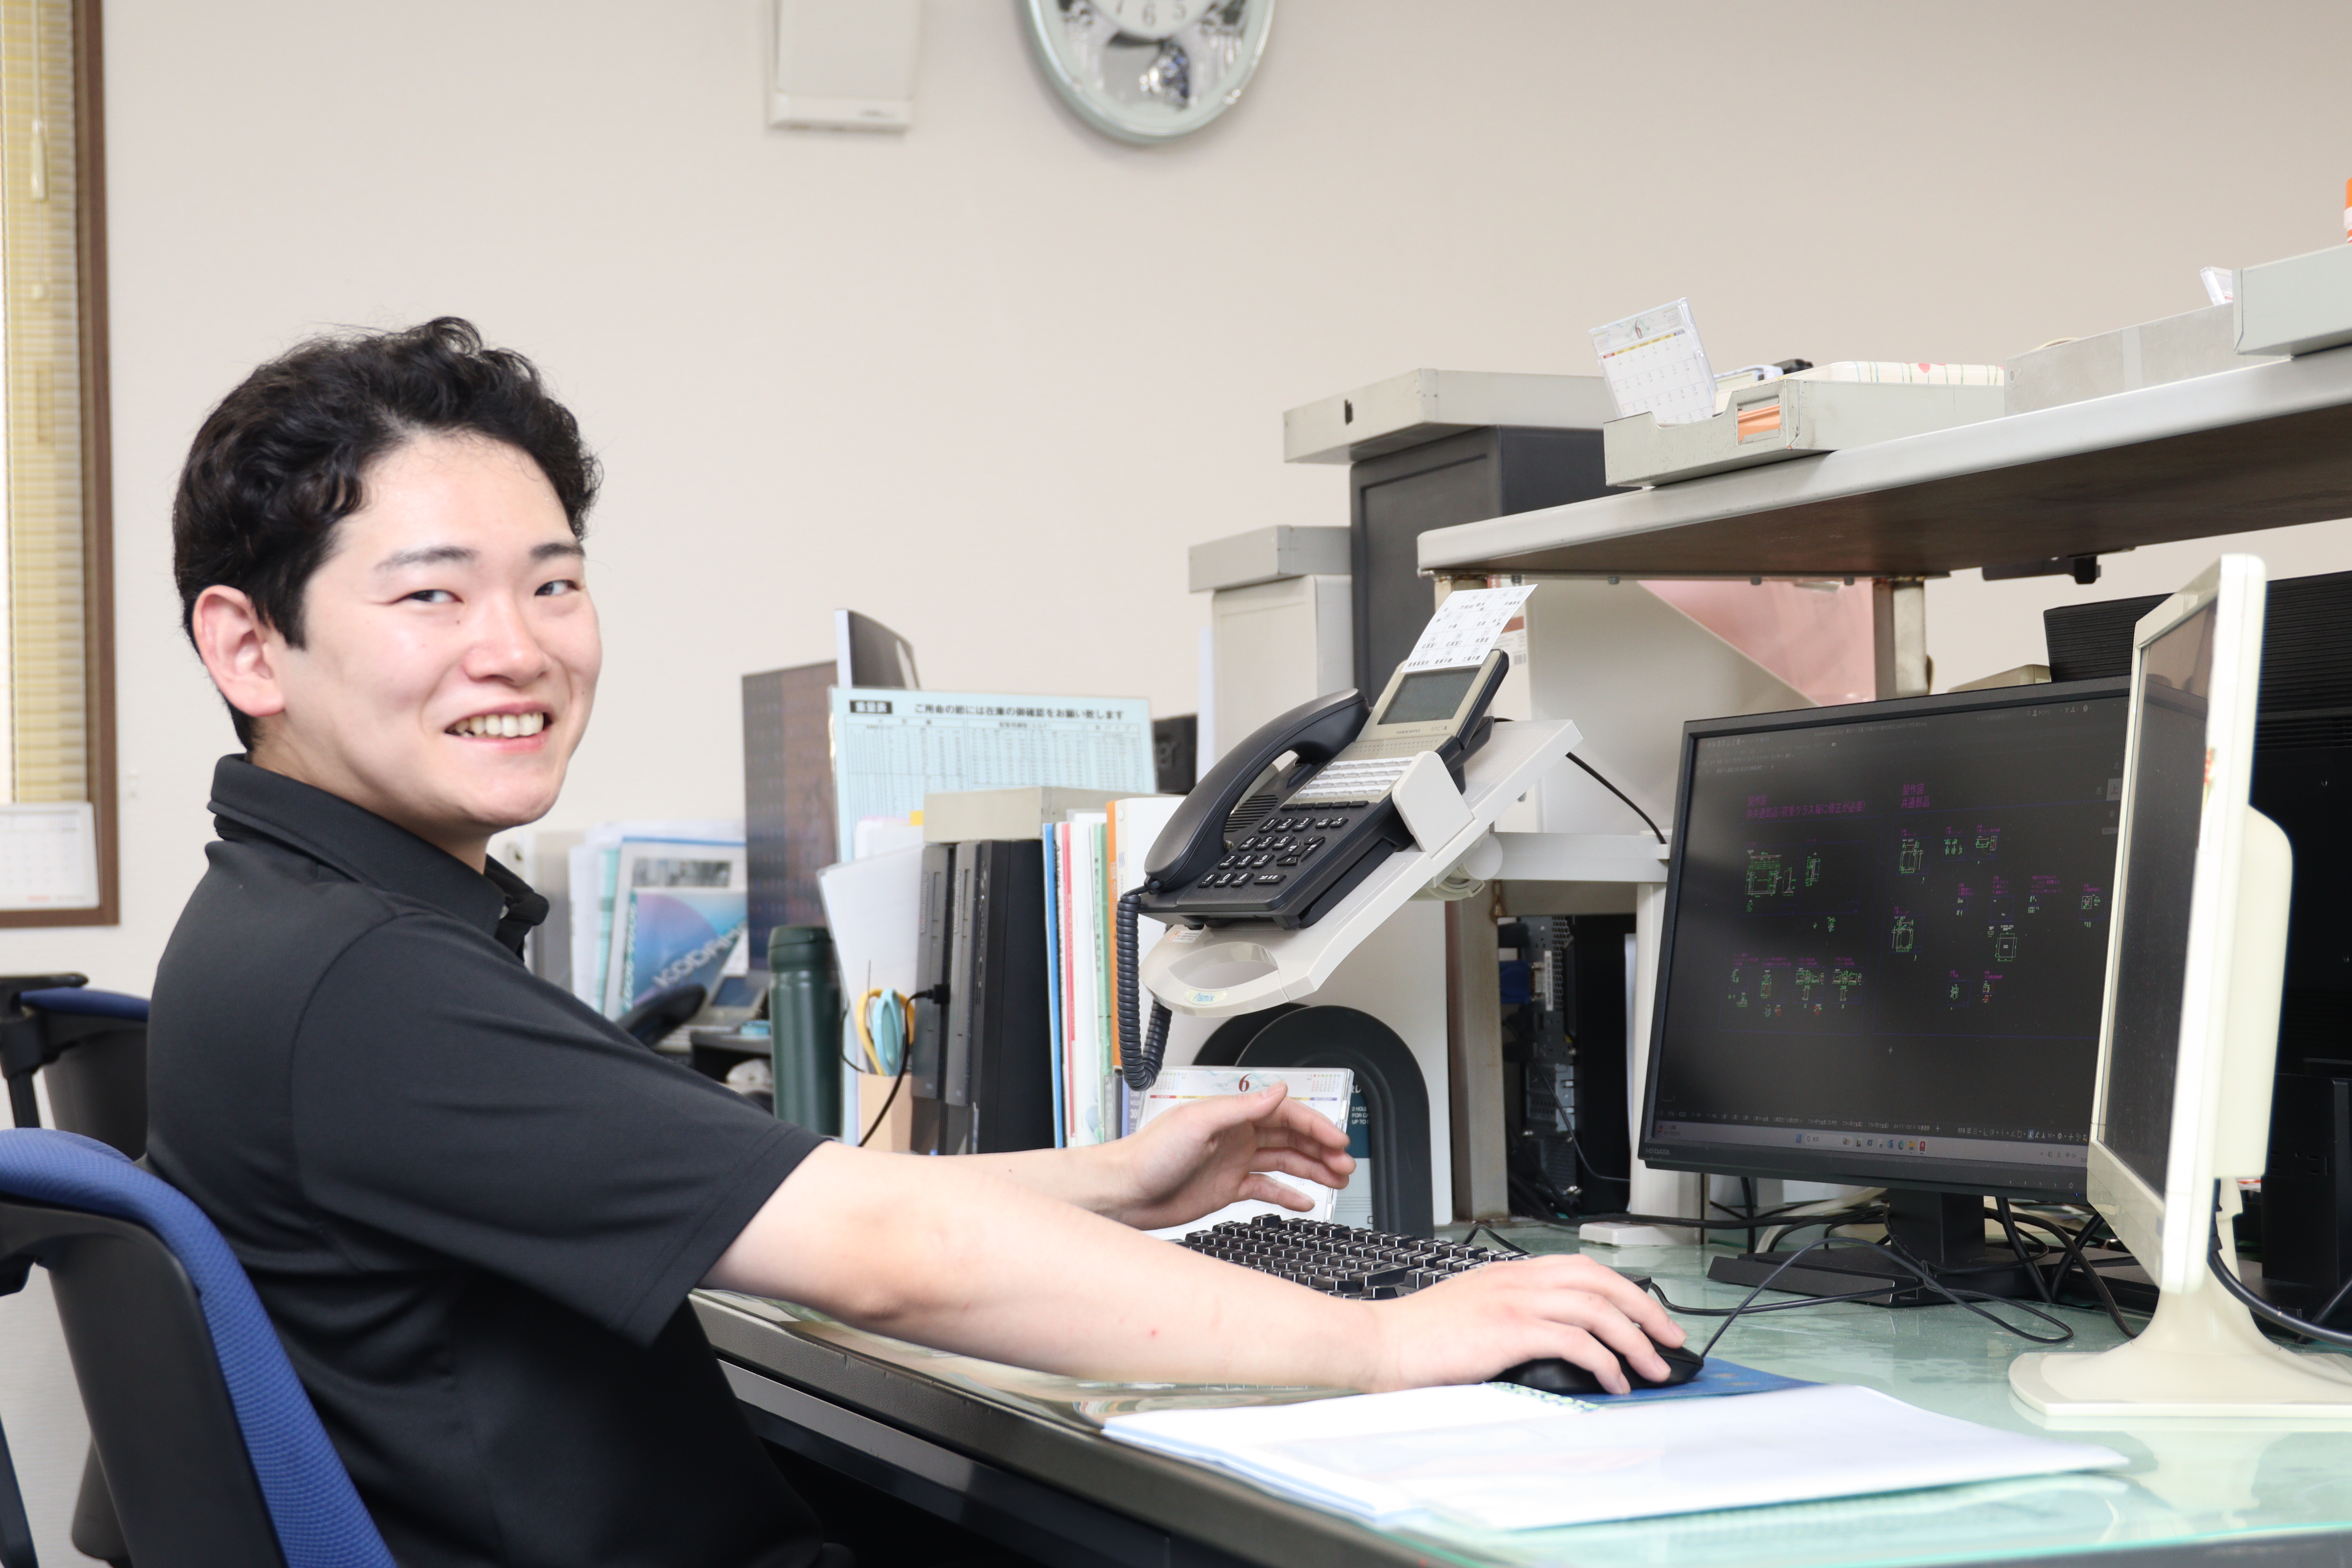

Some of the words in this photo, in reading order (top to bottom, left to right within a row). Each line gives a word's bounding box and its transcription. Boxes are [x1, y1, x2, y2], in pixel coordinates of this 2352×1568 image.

[1143, 6, 1156, 27] 6
[1634, 319, 1642, 339] 6
[1902, 783, 1924, 796] 製作図
[2110, 785, 2118, 794] 上
[1901, 796, 1930, 809] 共通部品
[1192, 993, 1216, 1002] Asmix
[1238, 1073, 1252, 1092] 6
